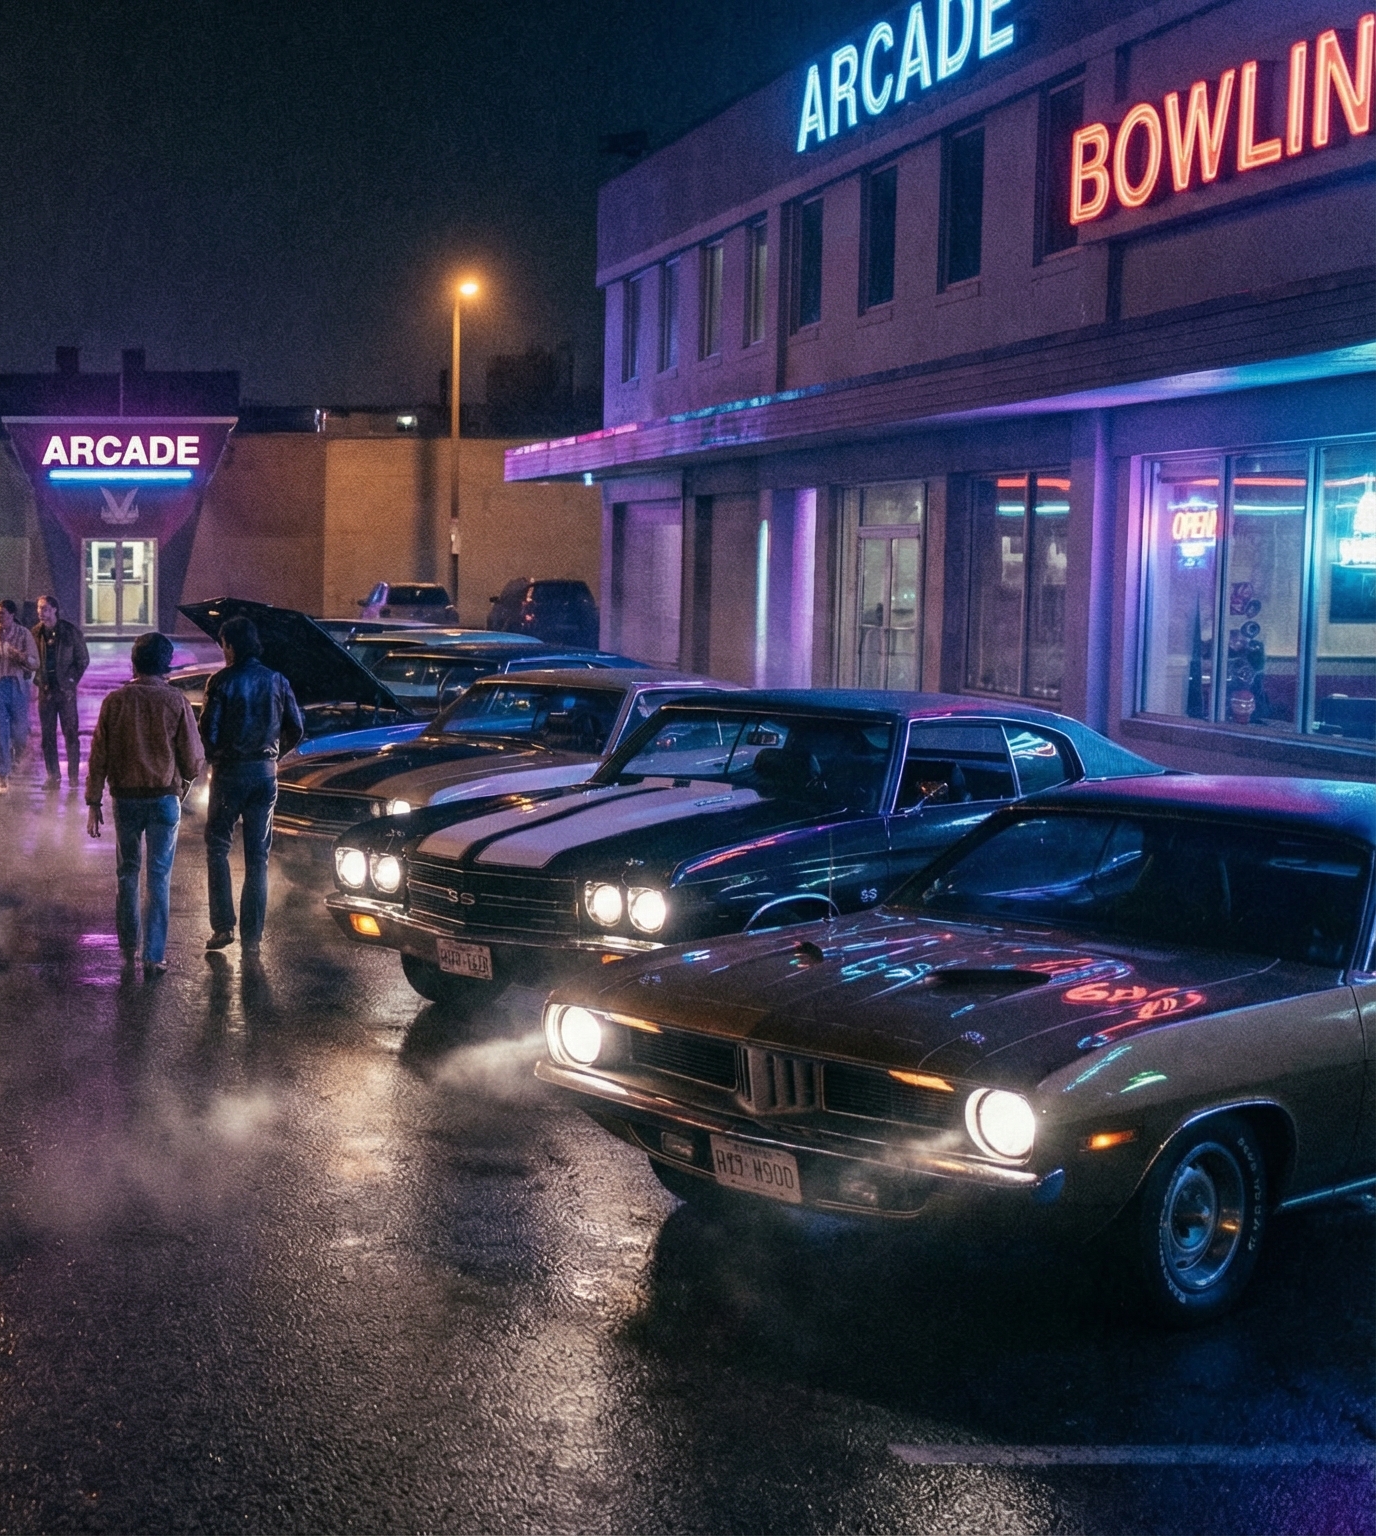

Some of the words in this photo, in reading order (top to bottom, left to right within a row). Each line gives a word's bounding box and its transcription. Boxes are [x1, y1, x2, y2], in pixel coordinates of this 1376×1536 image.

[796, 0, 1016, 153] ARCADE
[1069, 13, 1376, 226] BOWLIN
[41, 435, 200, 466] ARCADE
[1172, 509, 1218, 541] OPEN
[860, 888, 877, 902] SS
